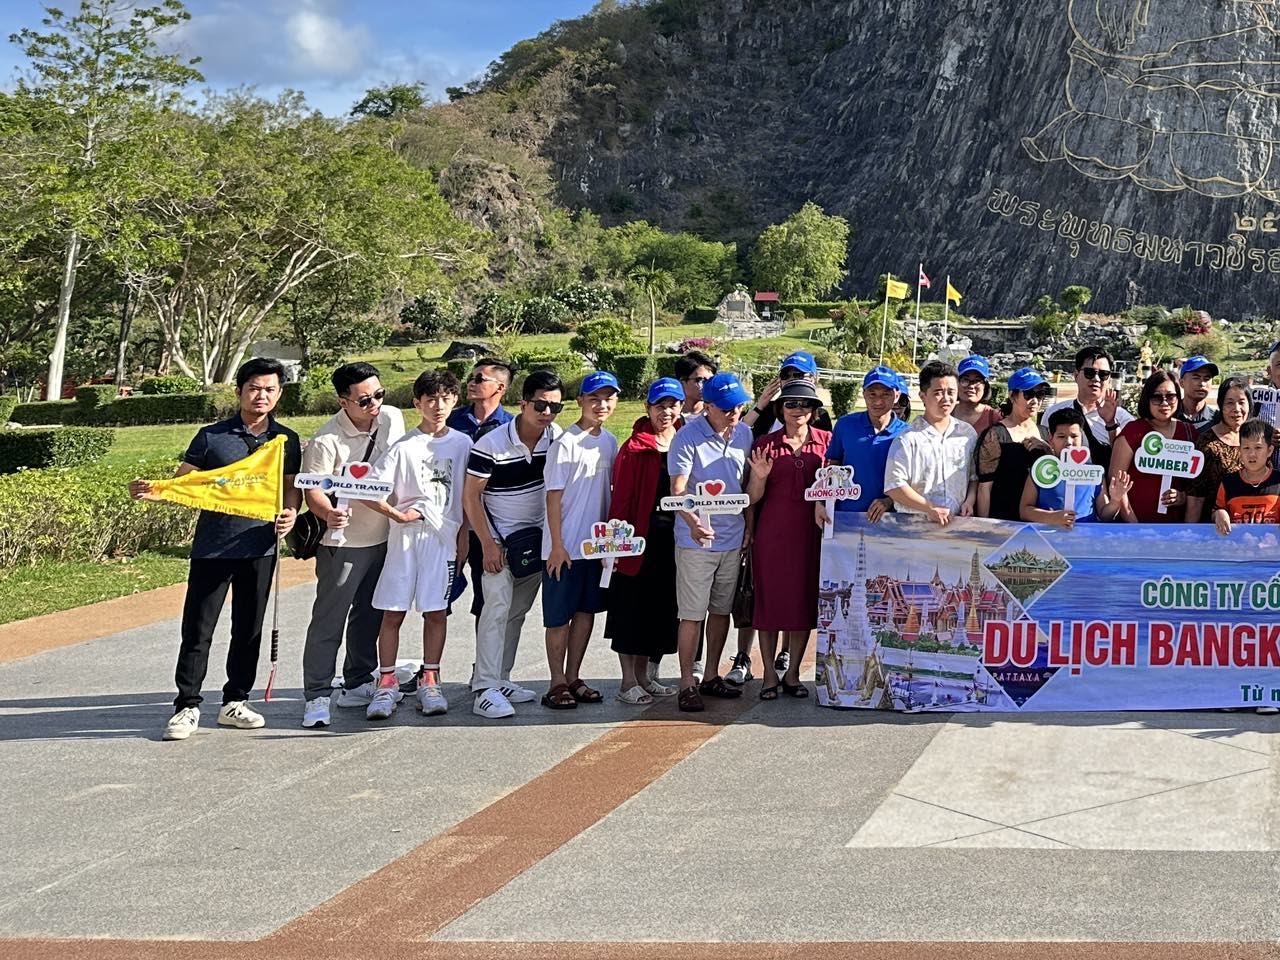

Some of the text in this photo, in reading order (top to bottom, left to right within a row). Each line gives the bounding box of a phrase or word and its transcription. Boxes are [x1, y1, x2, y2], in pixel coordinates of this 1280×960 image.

[1164, 443, 1192, 451] GOOVET
[1064, 451, 1068, 463] I
[1138, 456, 1200, 474] NUMBER 1
[1062, 469, 1101, 477] GOOVET
[354, 483, 391, 492] TRAVEL
[1142, 576, 1208, 608] CÔNG
[1216, 583, 1244, 608] TY
[984, 622, 1037, 665] DU
[1050, 623, 1136, 676] LỊCH
[1241, 684, 1264, 702] Từ
